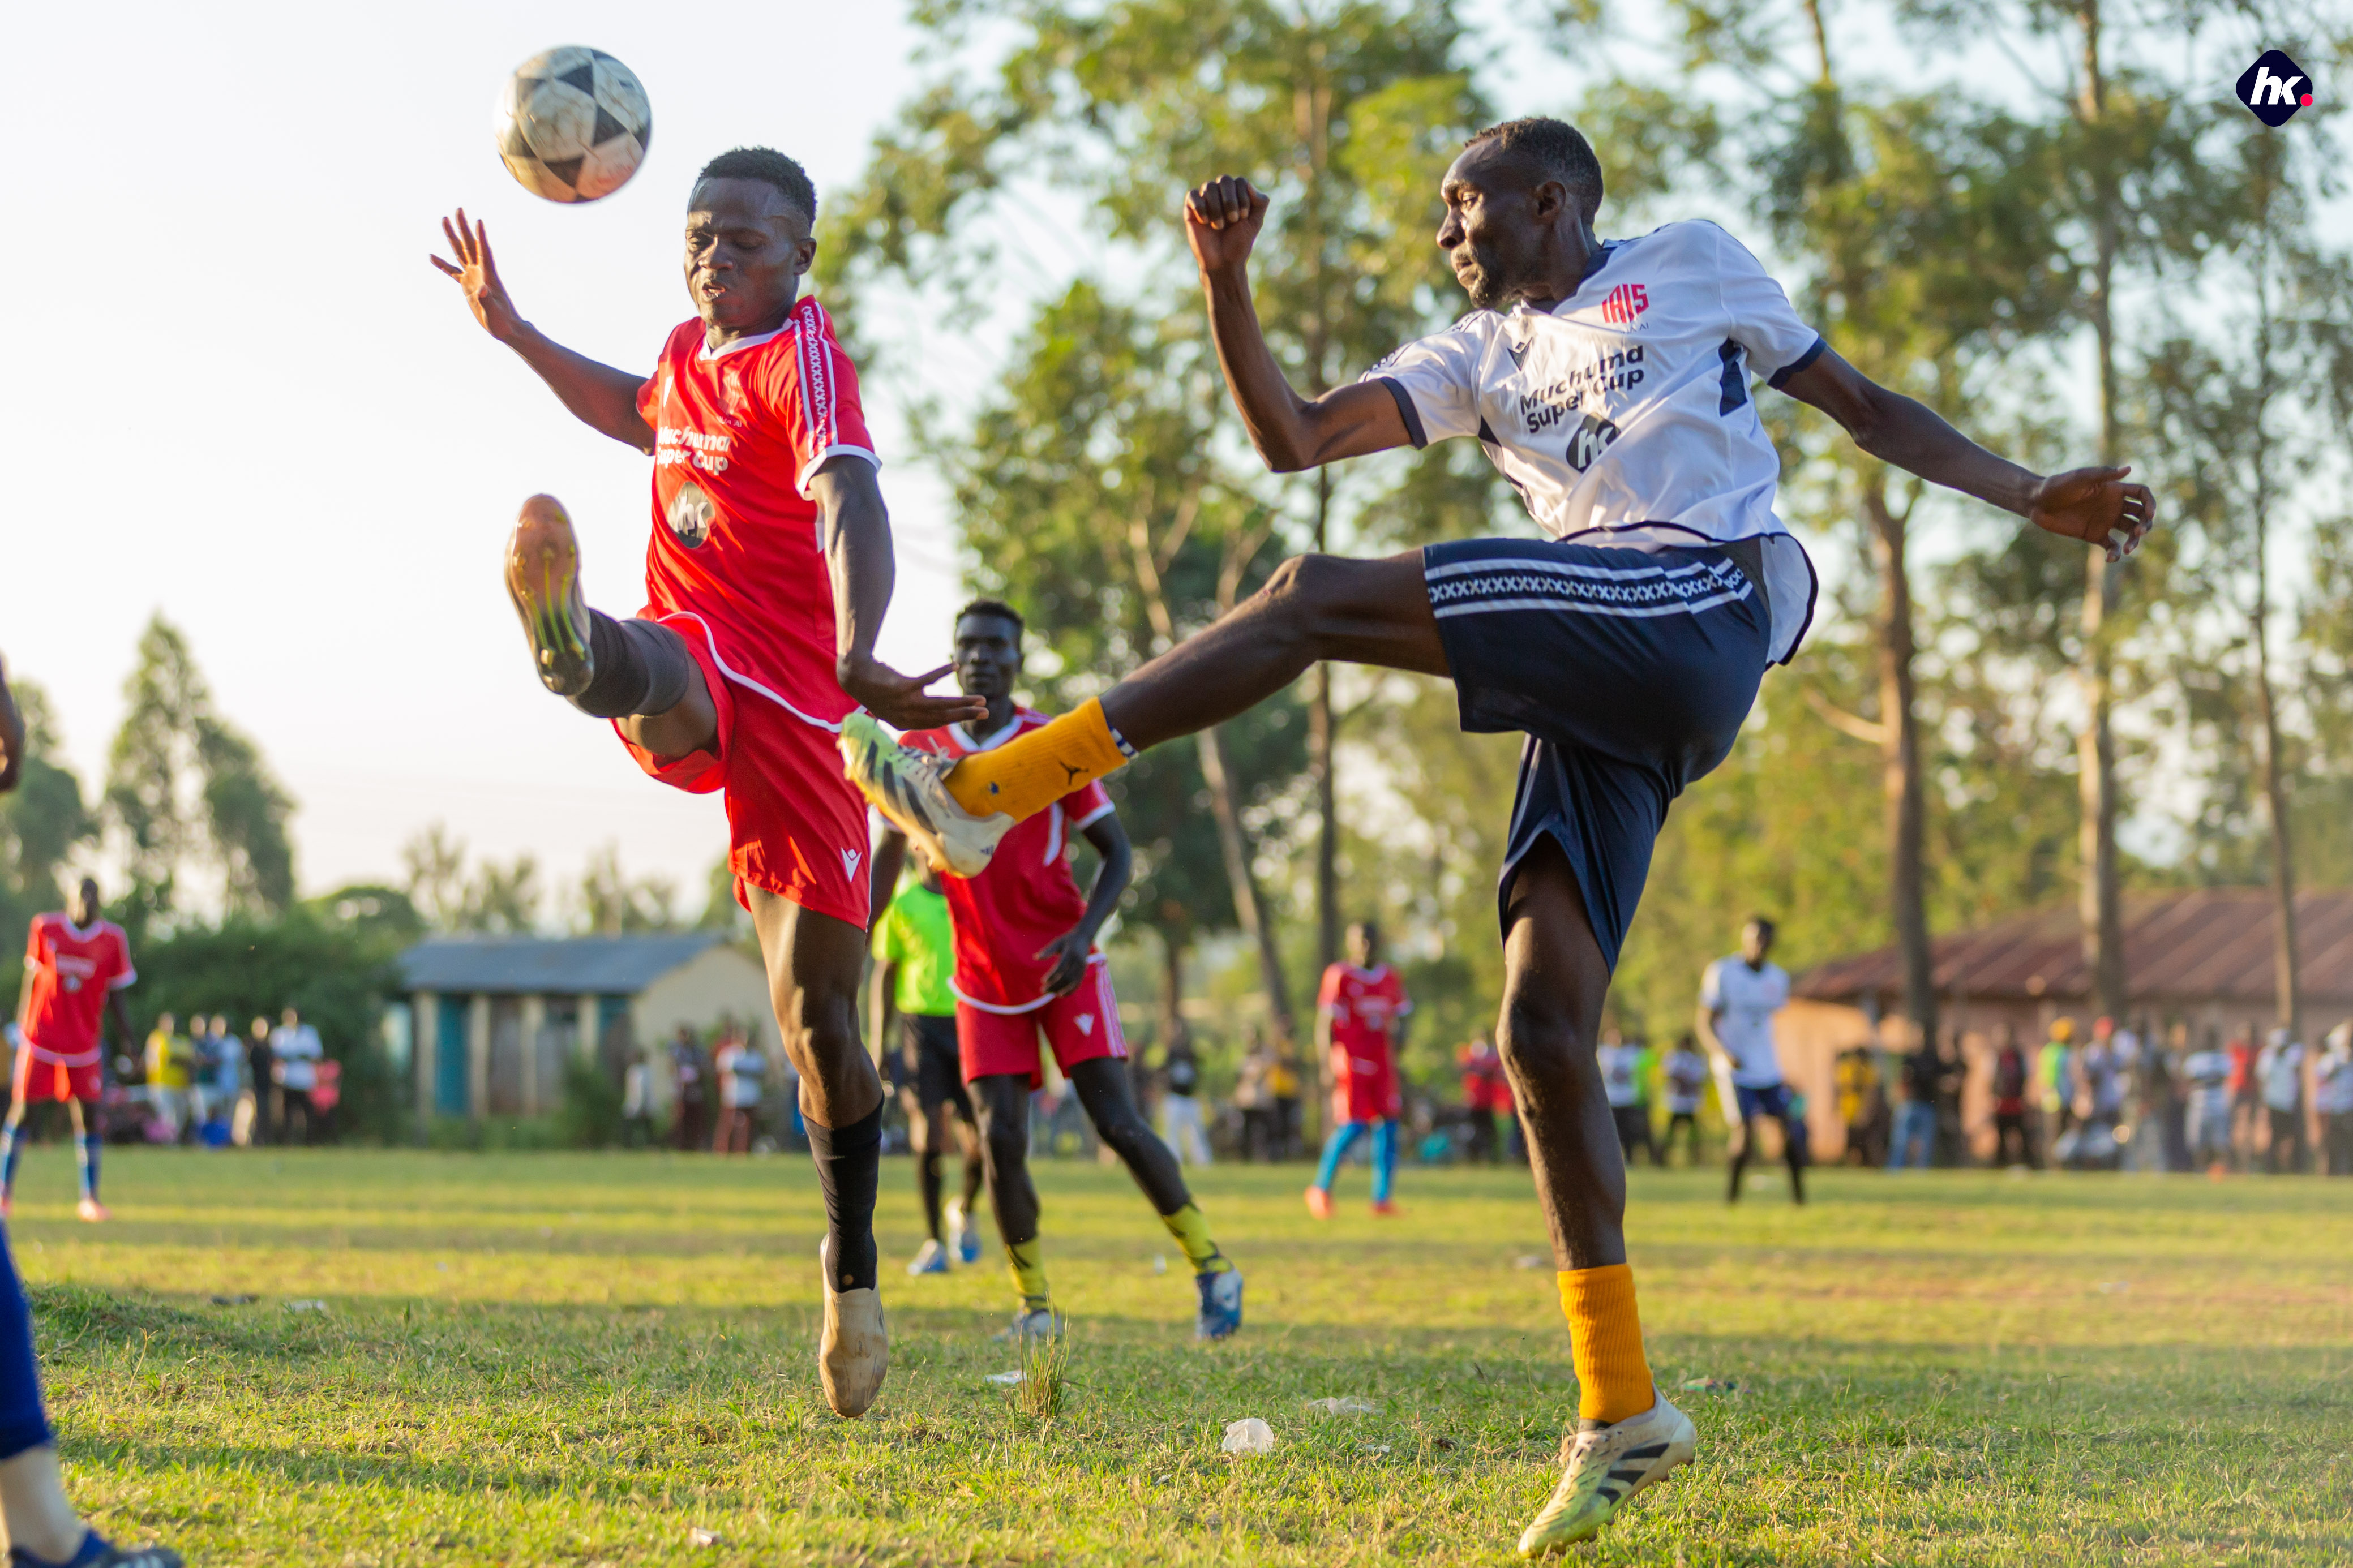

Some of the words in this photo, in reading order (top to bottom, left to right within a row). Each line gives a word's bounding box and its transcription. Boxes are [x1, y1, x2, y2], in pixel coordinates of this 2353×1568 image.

[1527, 389, 1587, 433] Super
[1593, 368, 1644, 396] Cup
[693, 450, 728, 475] Cup
